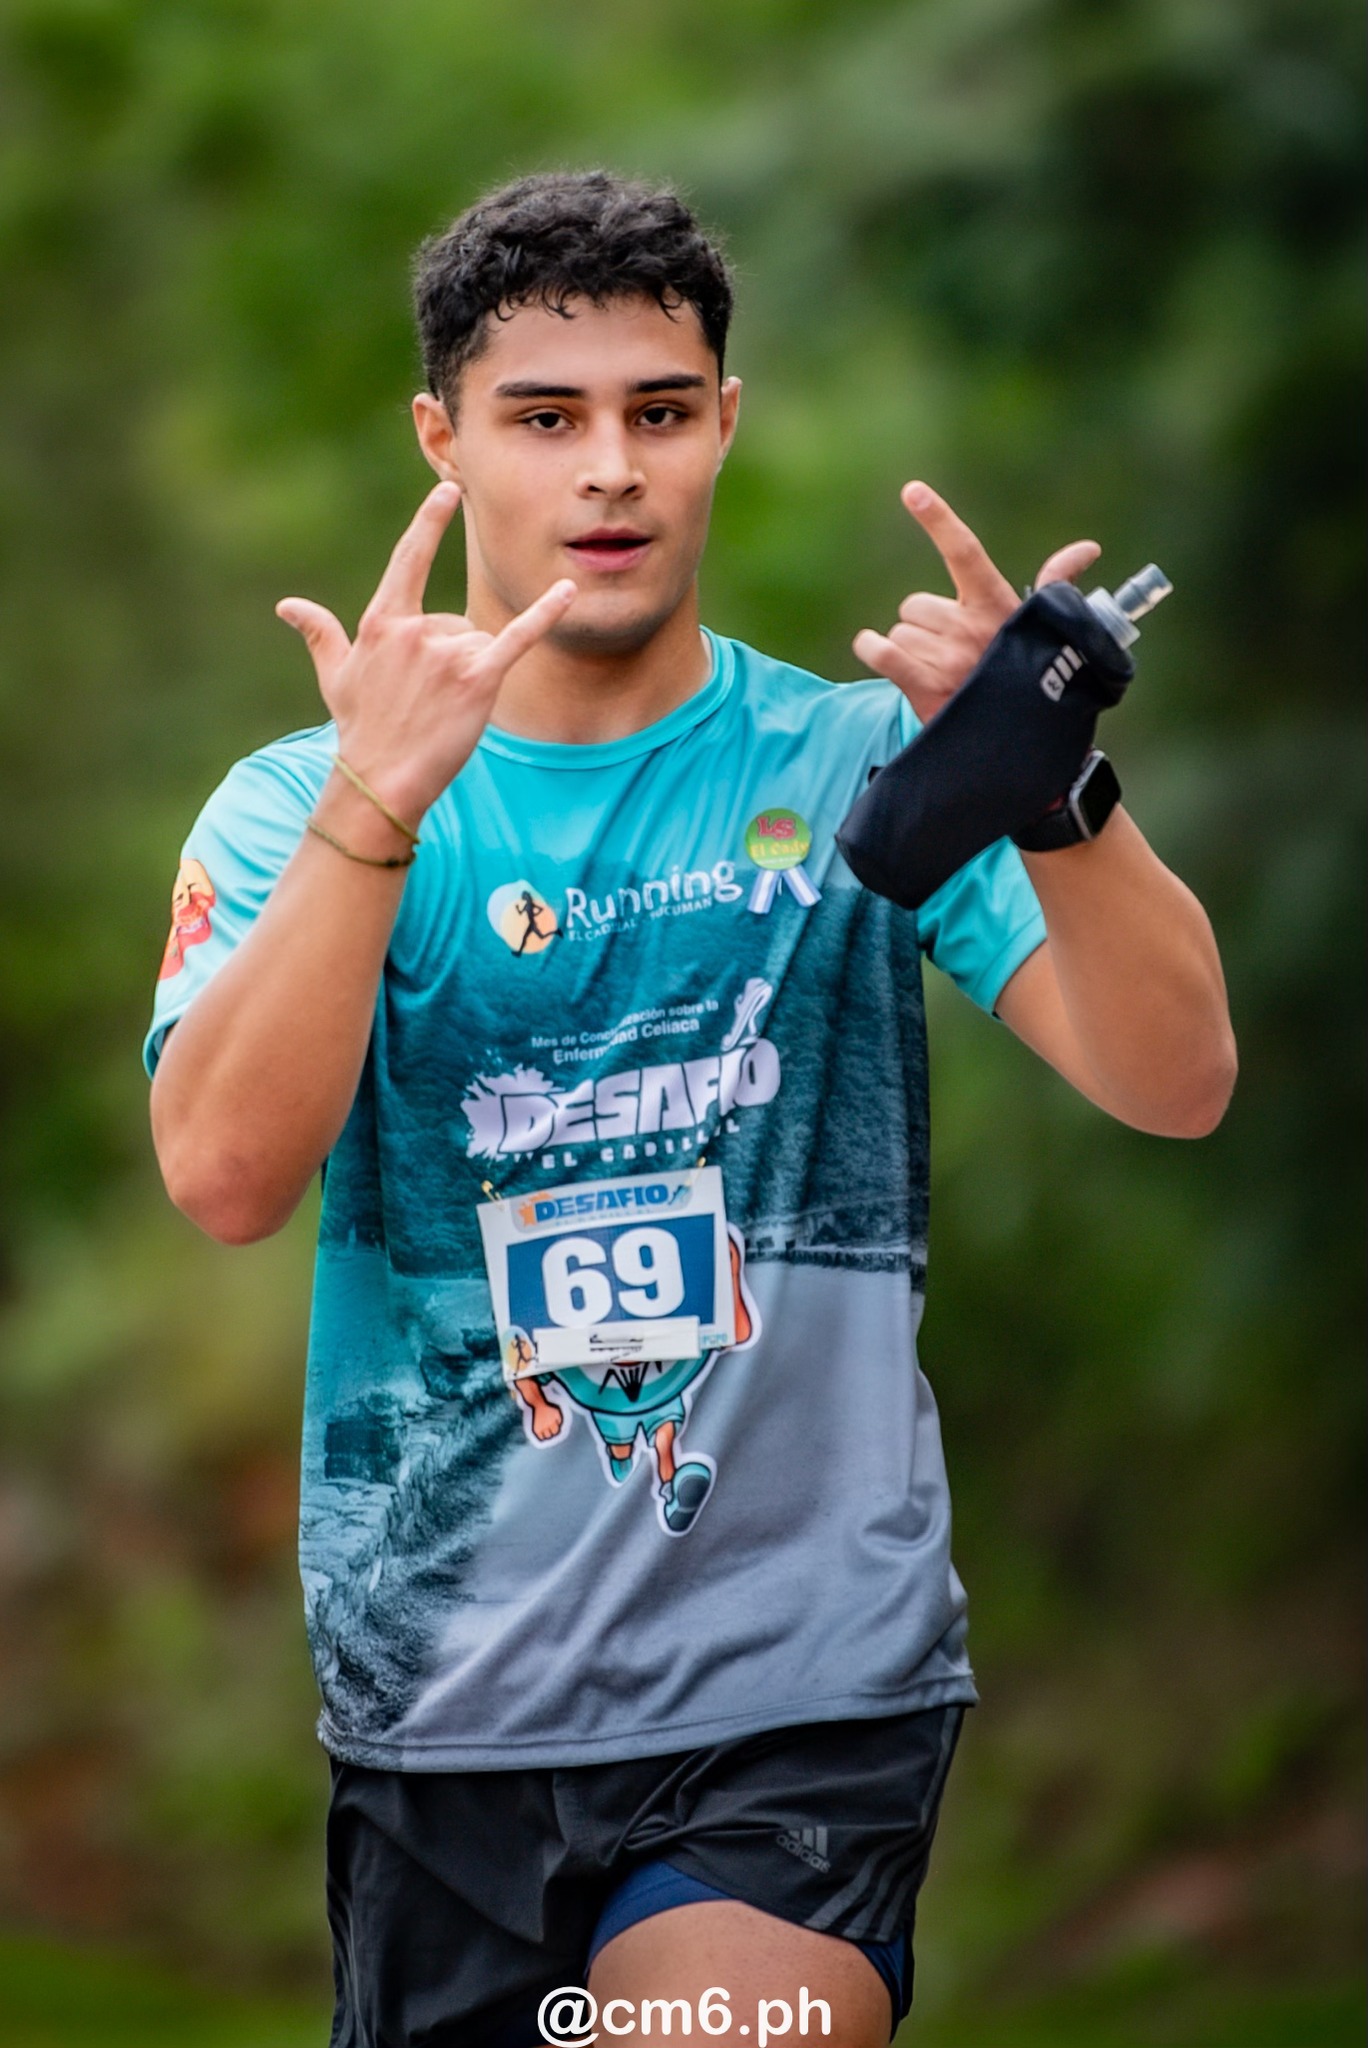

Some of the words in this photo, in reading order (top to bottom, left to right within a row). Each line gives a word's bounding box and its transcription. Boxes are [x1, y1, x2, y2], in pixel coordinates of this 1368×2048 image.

[564, 860, 744, 929] Running
[531, 1036, 558, 1049] Mes
[562, 1034, 577, 1047] de
[668, 1000, 705, 1017] sobre
[541, 1151, 578, 1170] EL
[534, 1183, 669, 1223] DESAFIO
[541, 1226, 686, 1329] 69
[776, 1833, 832, 1875] adidas
